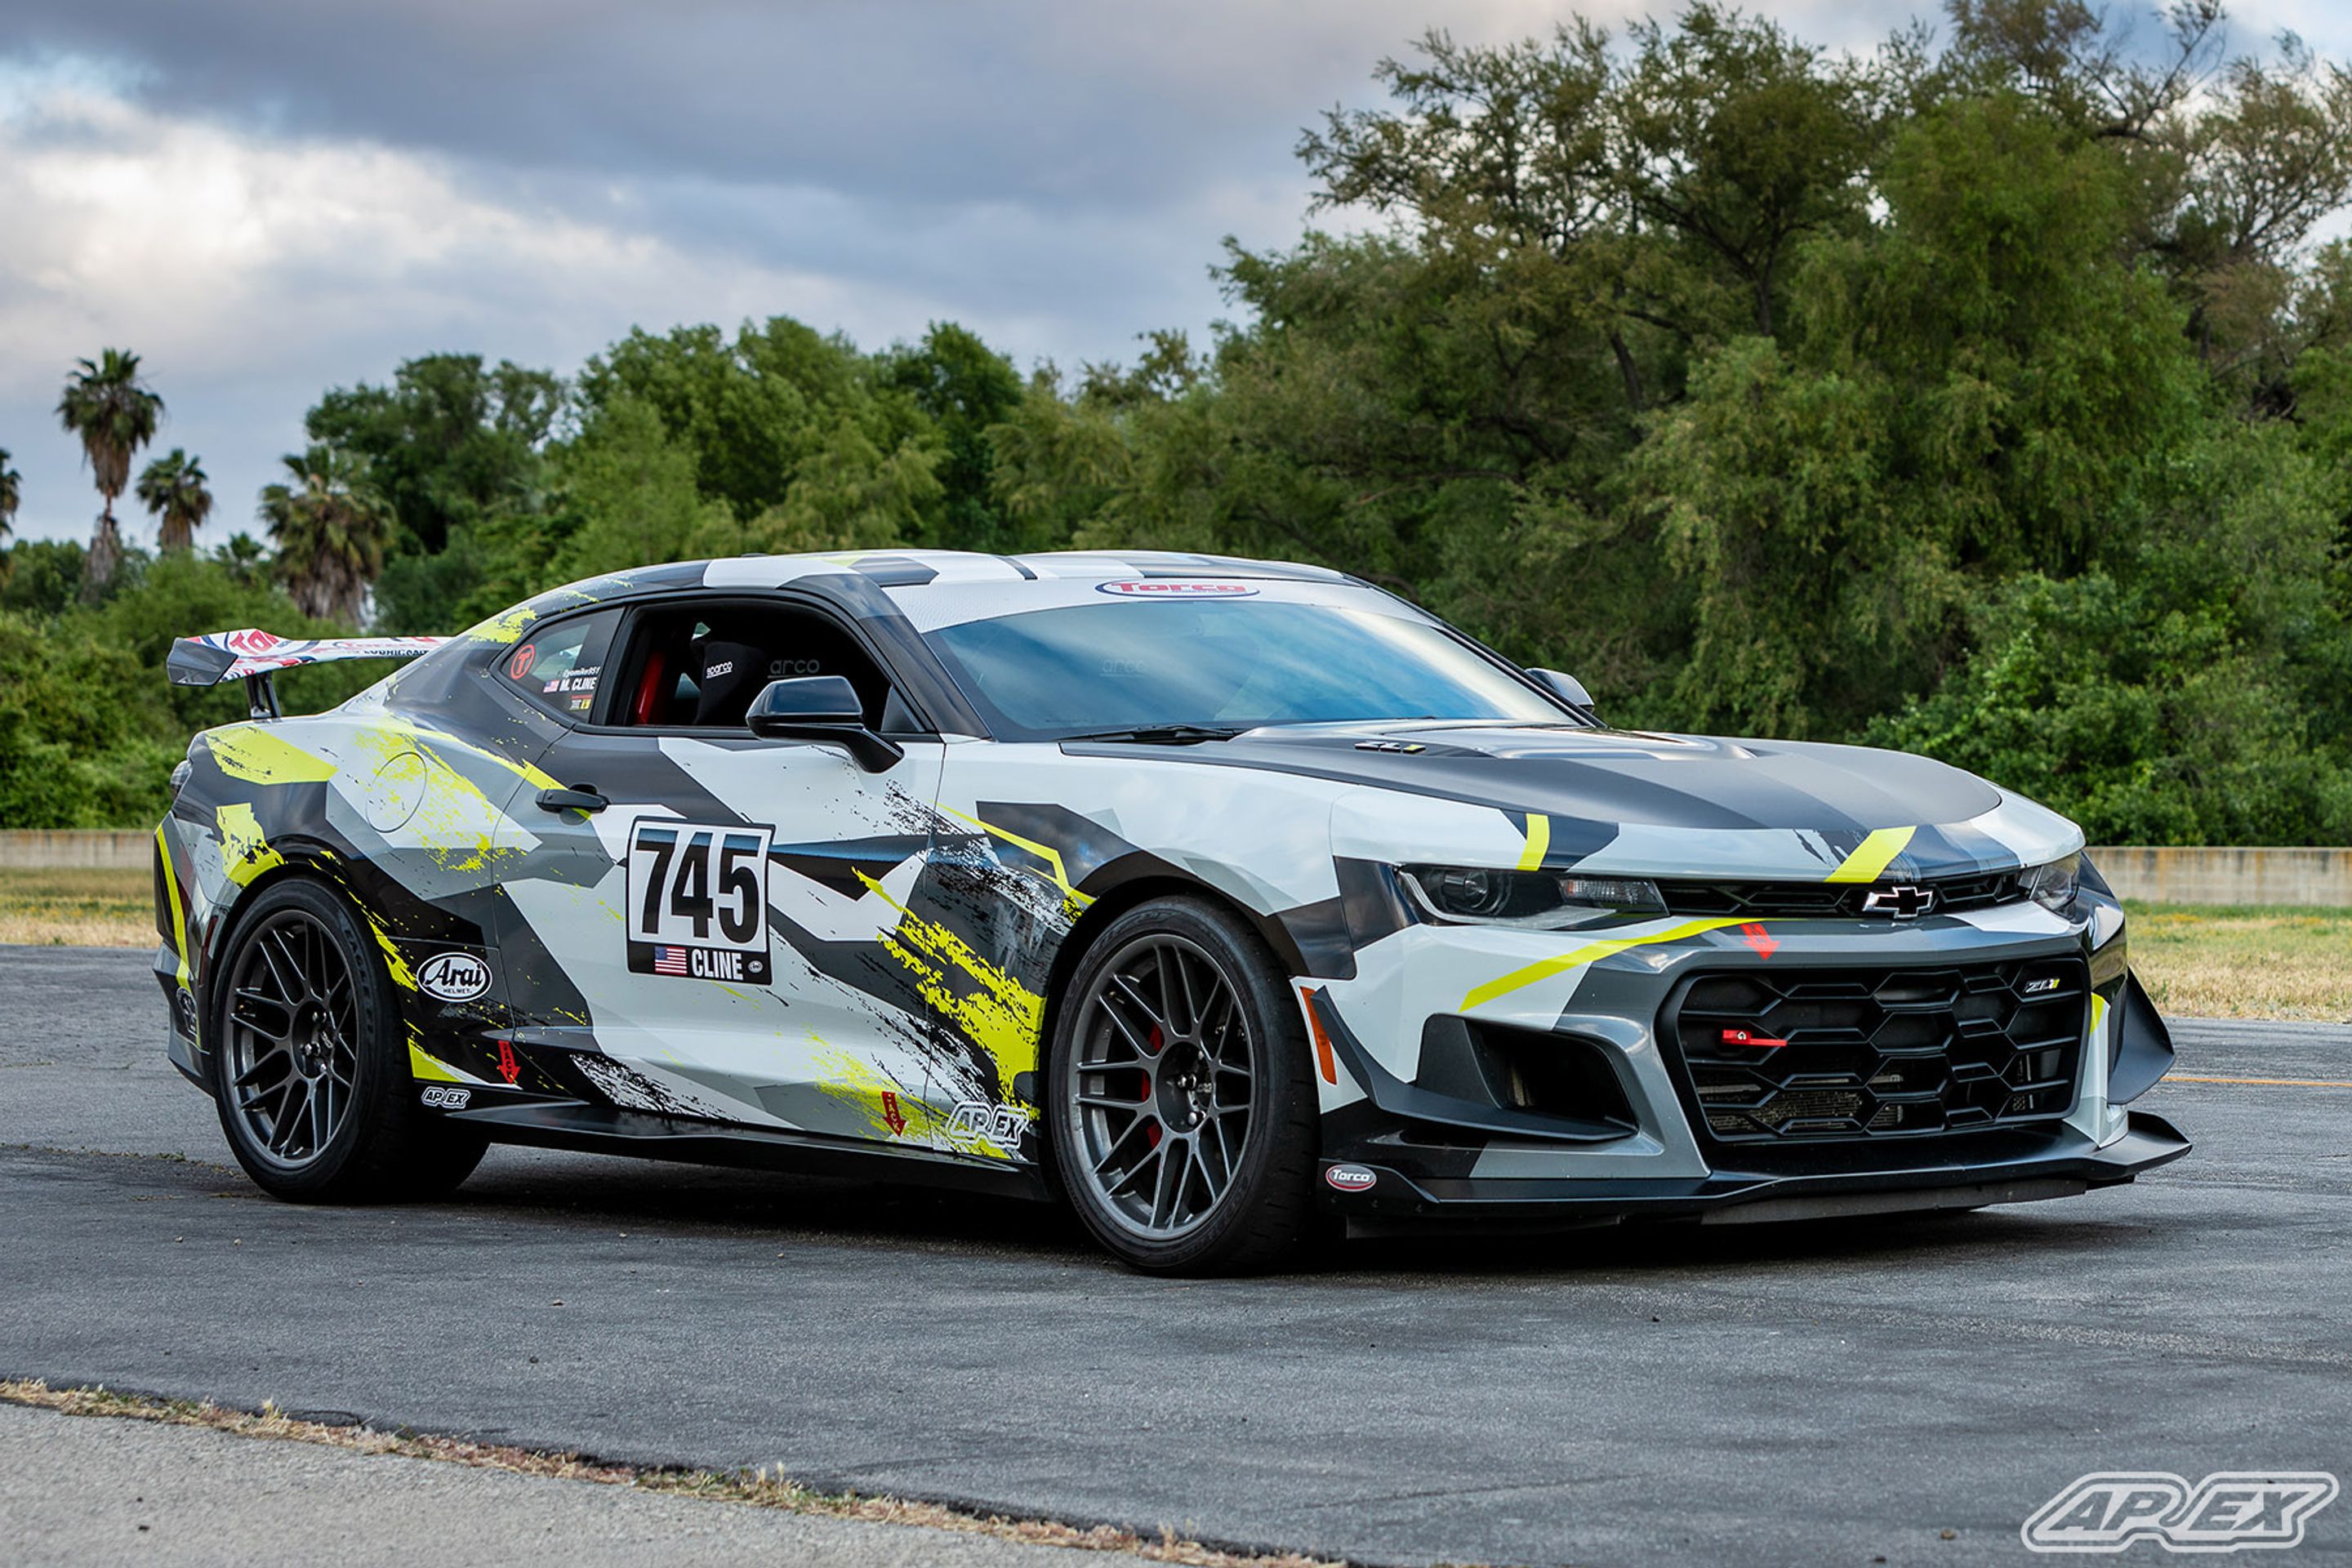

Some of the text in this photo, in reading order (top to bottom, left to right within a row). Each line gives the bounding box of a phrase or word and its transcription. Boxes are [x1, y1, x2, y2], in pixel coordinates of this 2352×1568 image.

[1111, 582, 1246, 592] Torco
[706, 662, 733, 678] sparco
[572, 677, 597, 691] CLINE
[635, 828, 762, 943] 745
[424, 960, 483, 987] Arai
[692, 949, 744, 980] CLINE
[950, 1104, 1026, 1145] APEX
[1333, 1169, 1370, 1182] Torco
